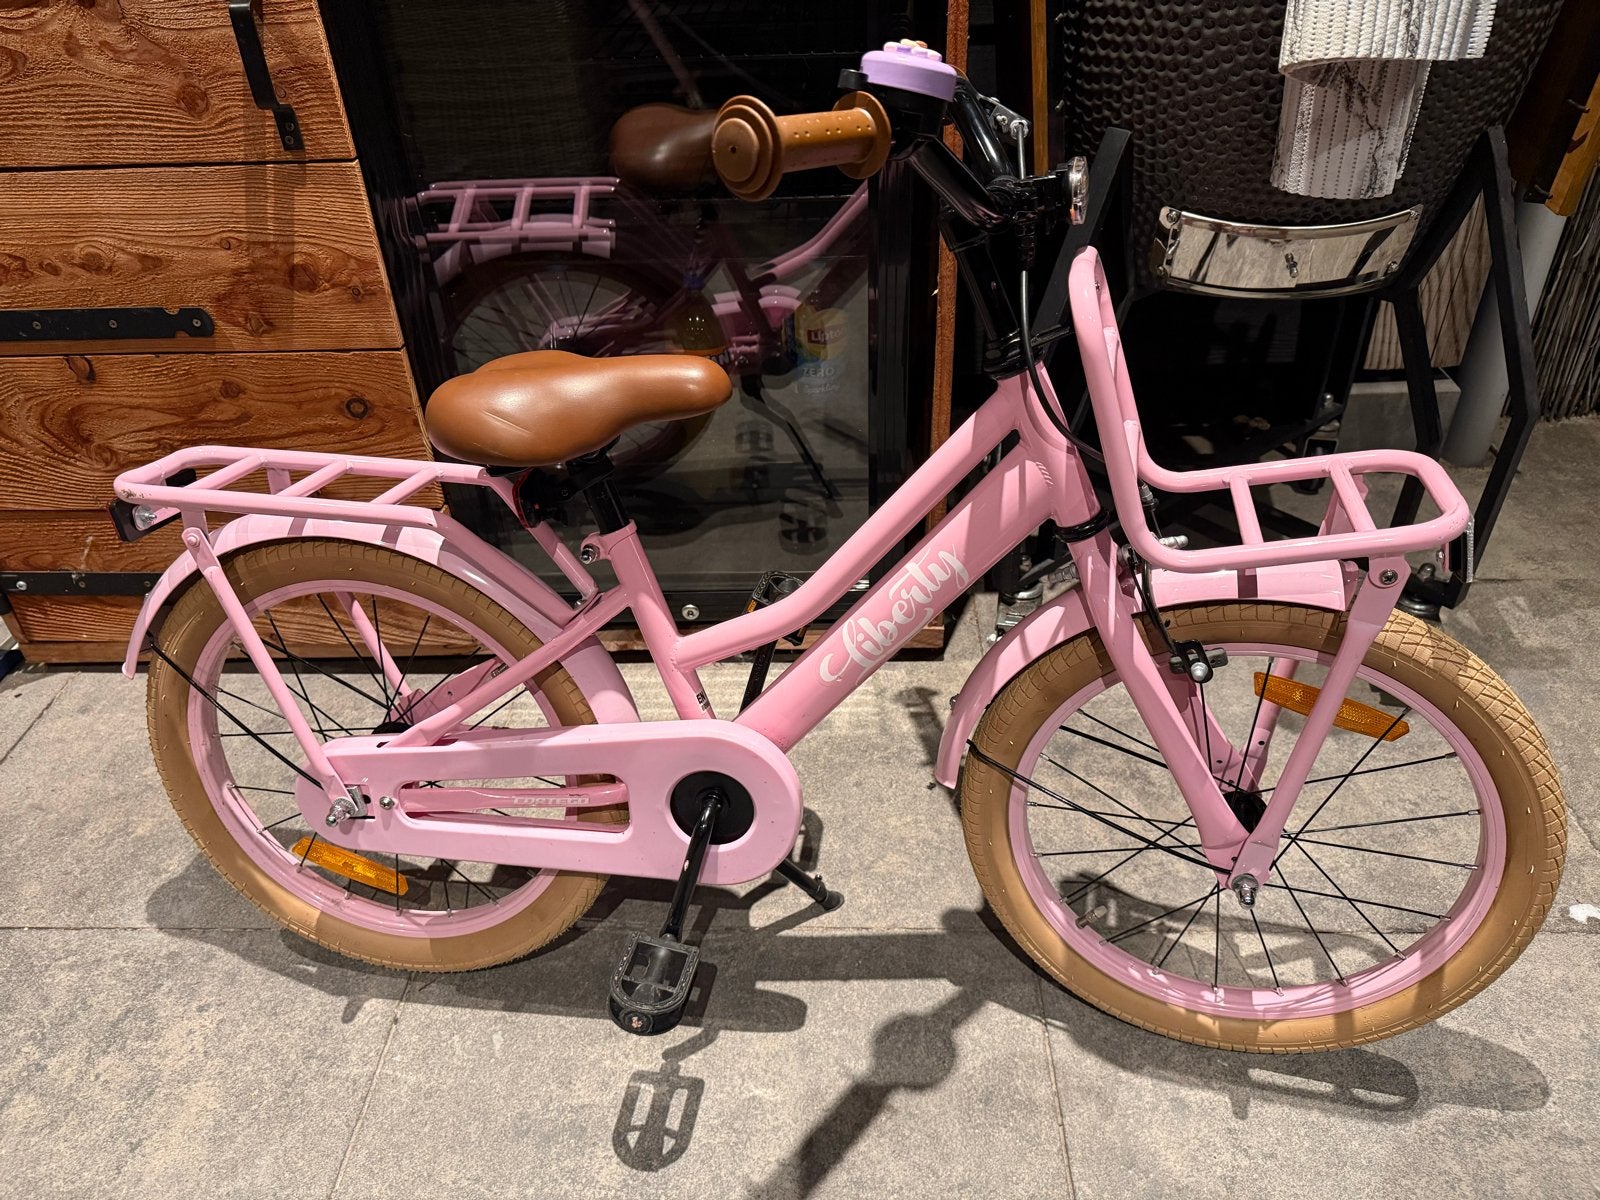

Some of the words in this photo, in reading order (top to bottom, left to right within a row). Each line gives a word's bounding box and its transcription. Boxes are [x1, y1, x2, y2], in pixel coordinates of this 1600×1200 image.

[811, 329, 844, 343] Lipto
[802, 367, 834, 377] ZERO
[819, 544, 969, 685] Liberty
